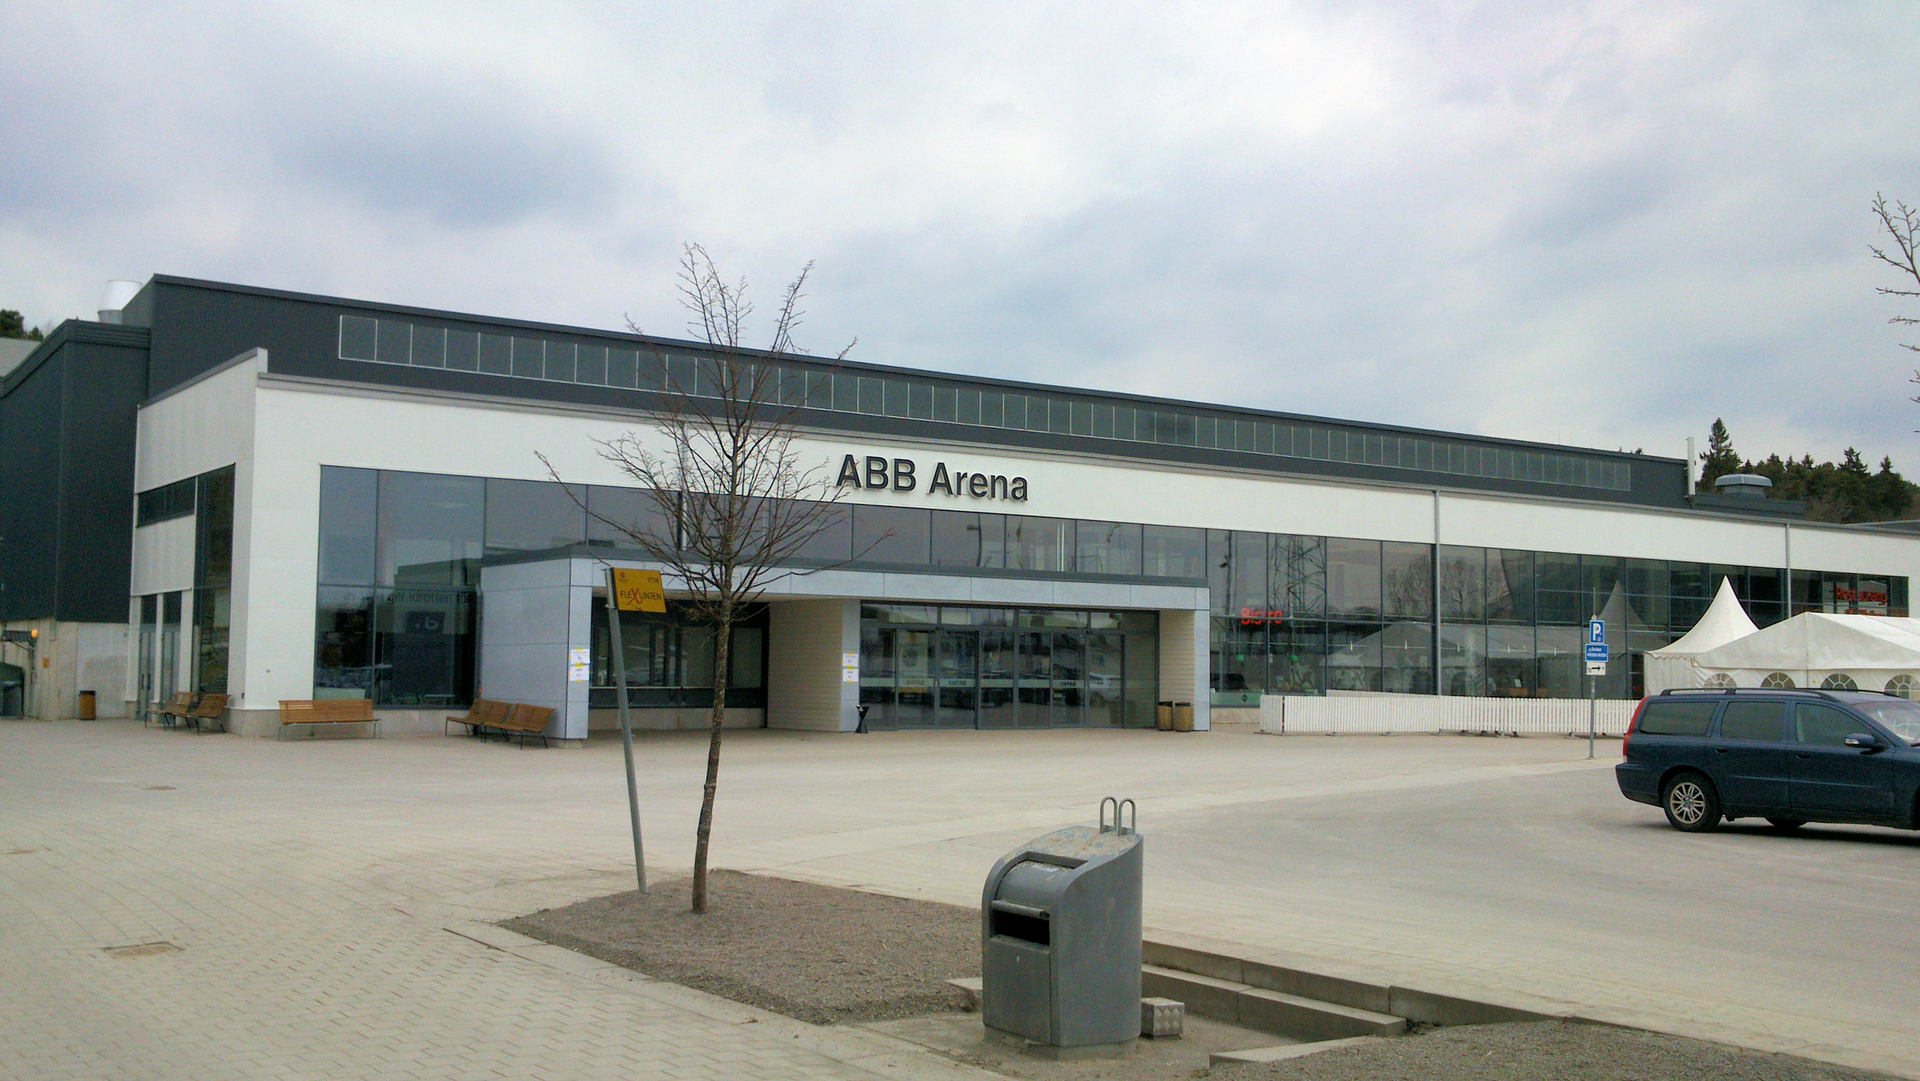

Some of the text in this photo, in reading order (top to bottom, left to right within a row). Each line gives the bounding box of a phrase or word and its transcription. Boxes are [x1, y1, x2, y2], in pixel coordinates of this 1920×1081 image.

[835, 454, 1028, 501] ABB Arena
[1241, 608, 1283, 625] Bistro
[1592, 623, 1602, 641] P
